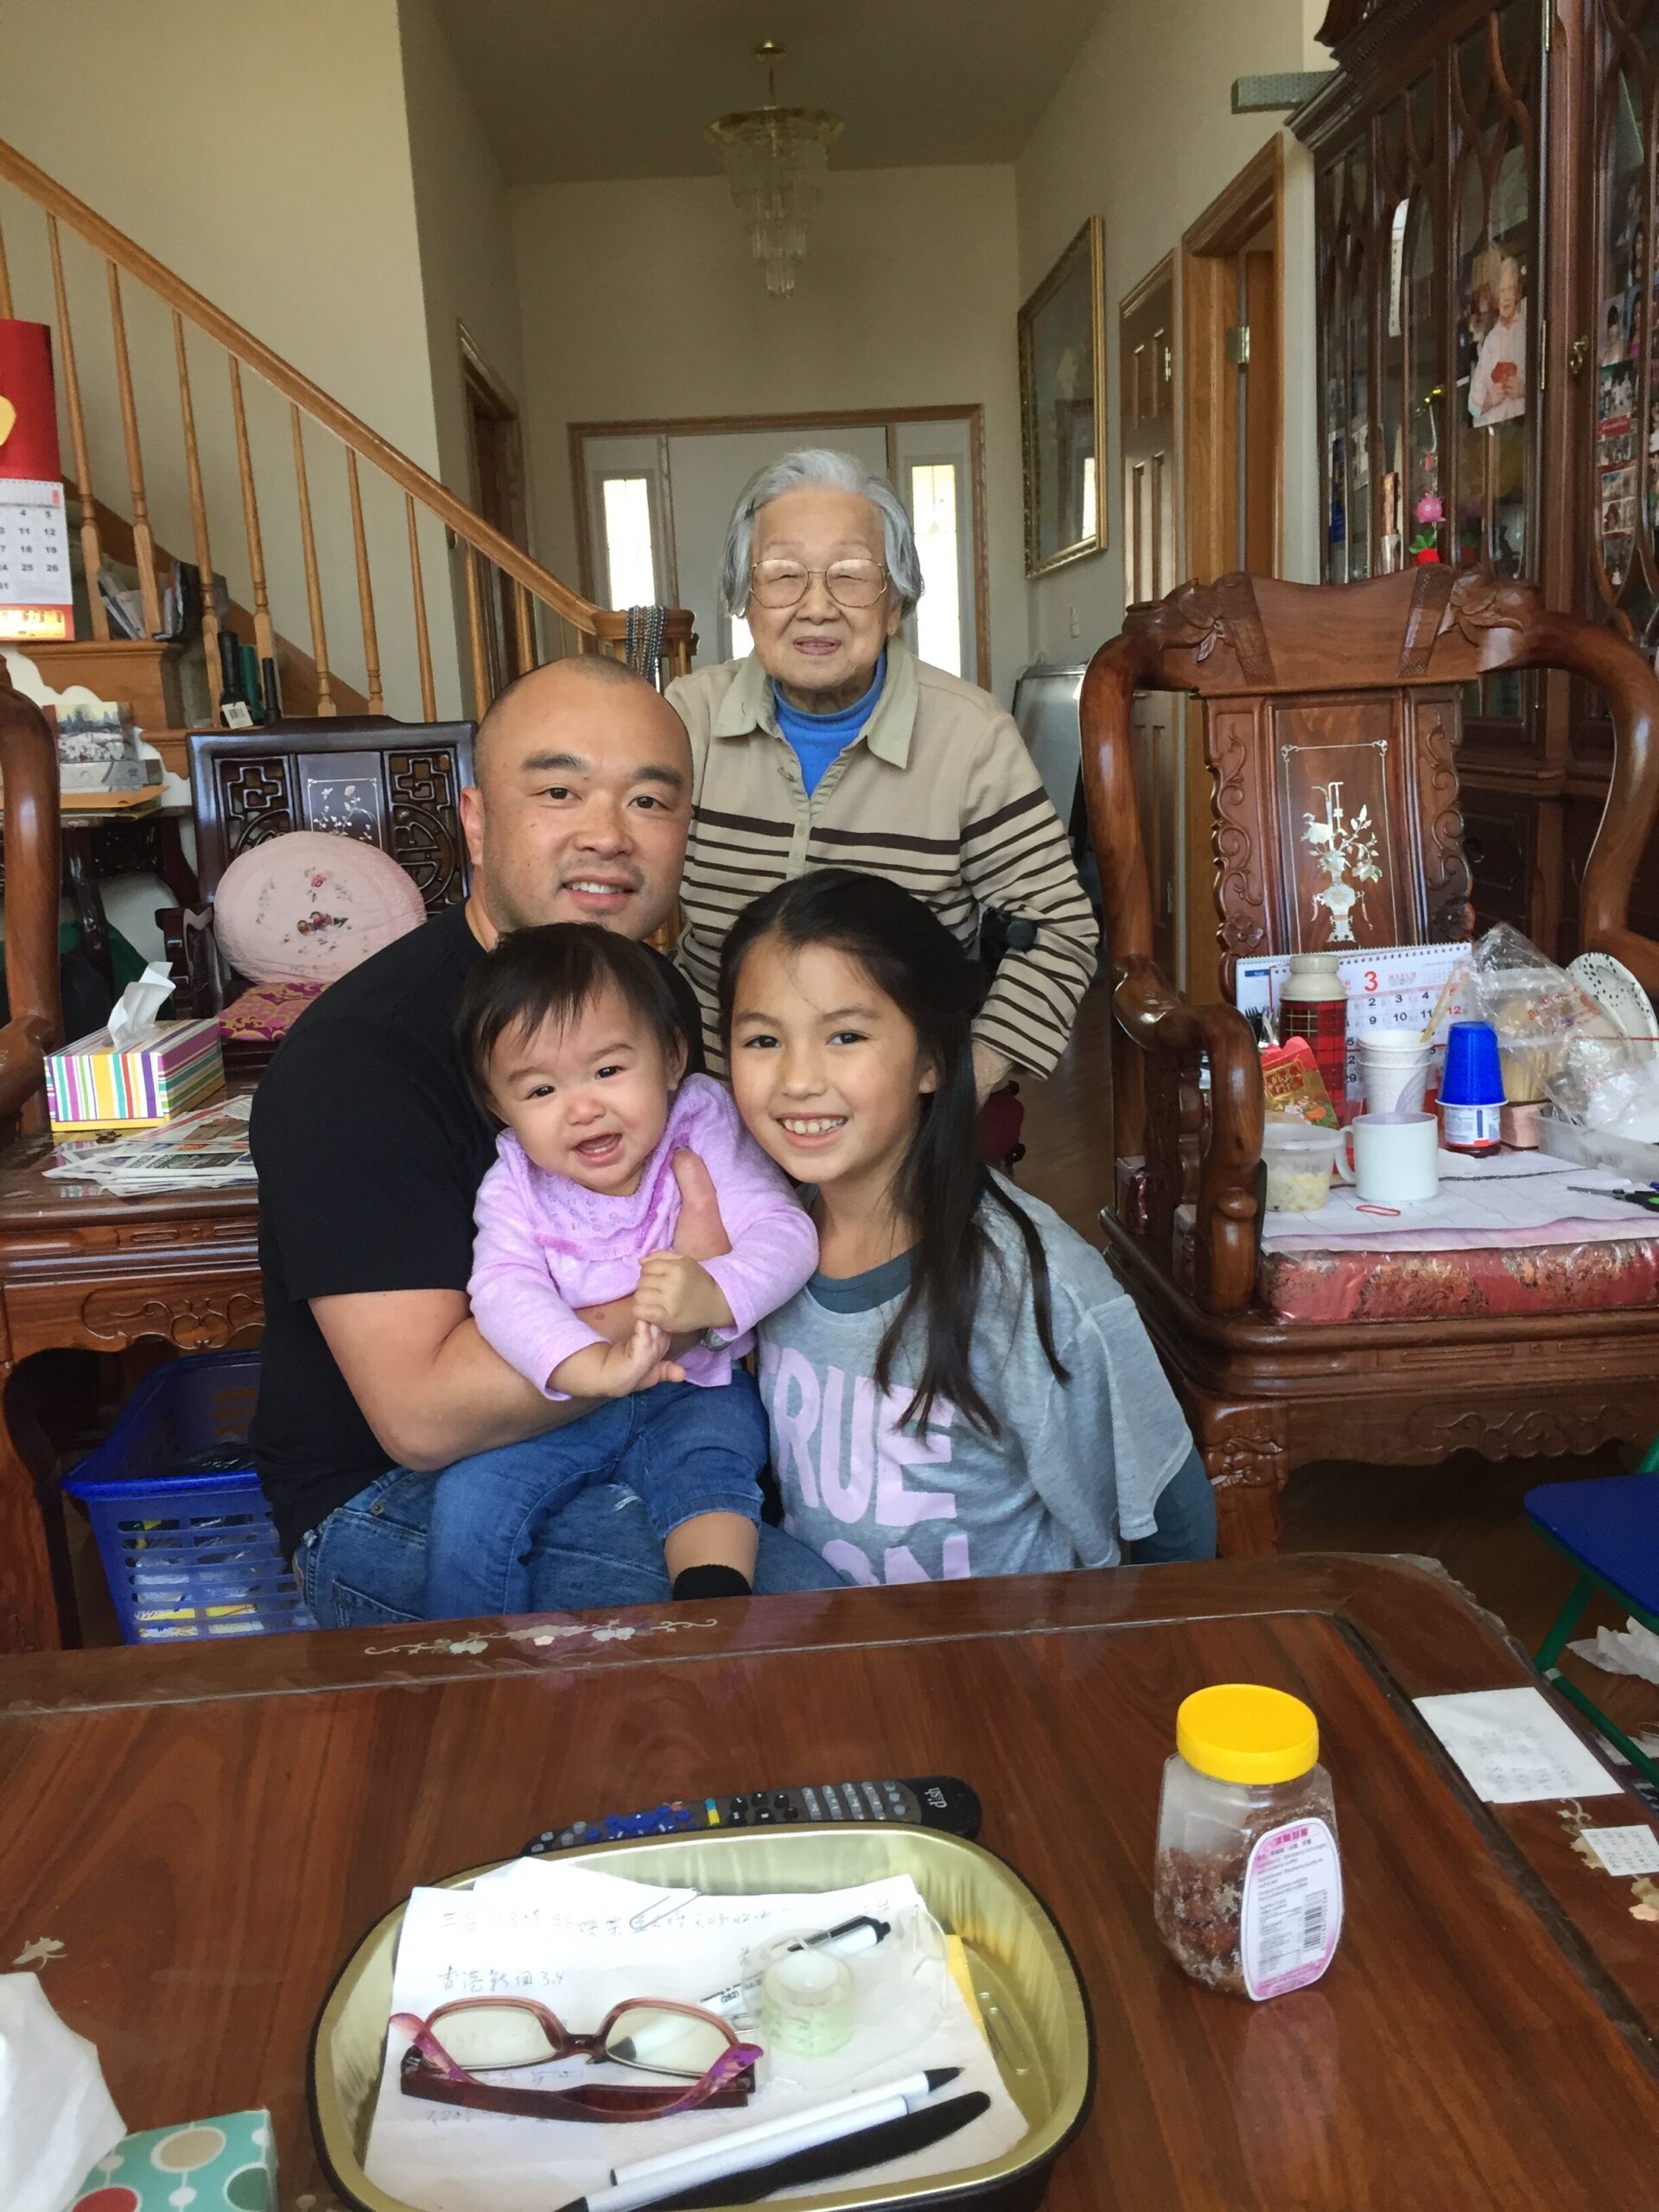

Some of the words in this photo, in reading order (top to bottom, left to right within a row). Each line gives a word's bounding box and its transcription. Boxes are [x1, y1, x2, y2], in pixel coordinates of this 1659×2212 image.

[1364, 970, 1378, 992] 3
[1389, 971, 1417, 980] MARCH
[1368, 997, 1376, 1007] 2
[1395, 994, 1403, 1003] 3
[1421, 991, 1429, 1000] 4
[1369, 1016, 1376, 1026] 9
[1393, 1012, 1408, 1023] 10
[1447, 1005, 1462, 1015] 12
[924, 1787, 948, 1808] dish
